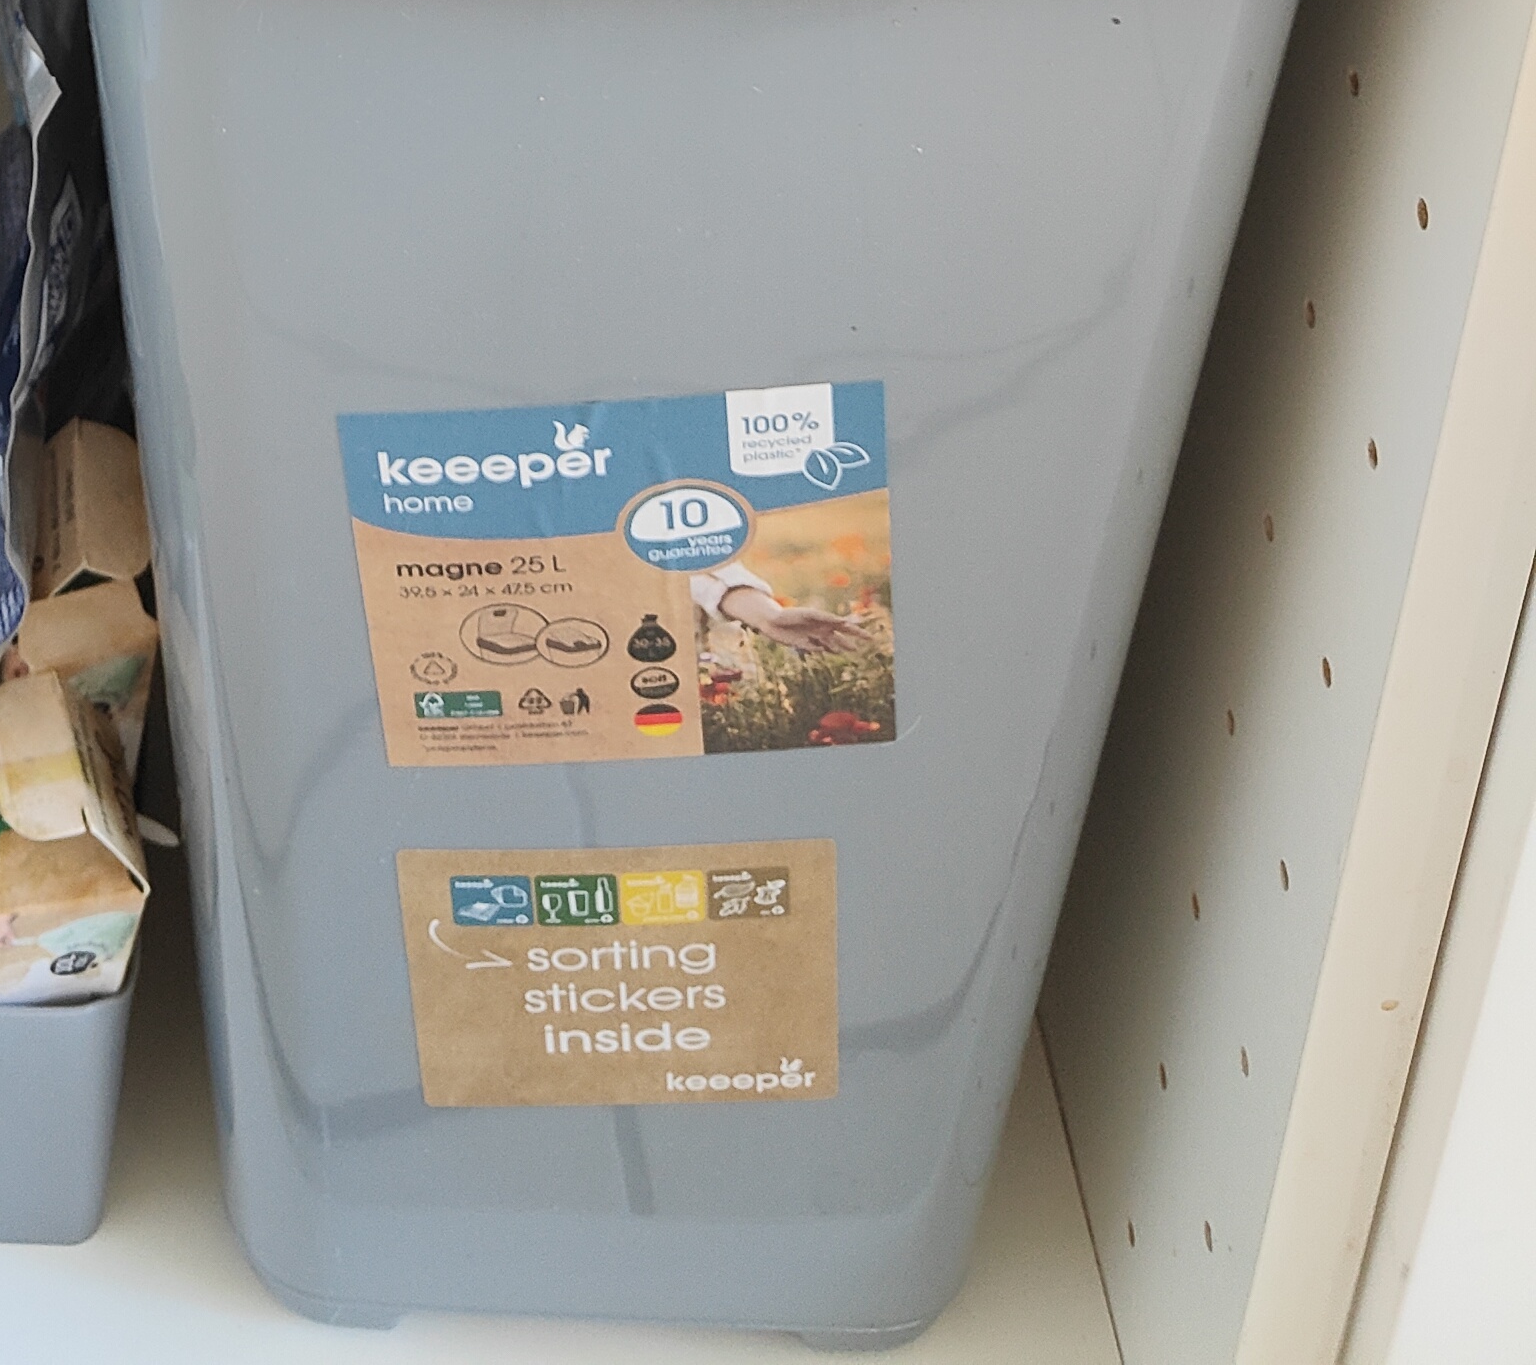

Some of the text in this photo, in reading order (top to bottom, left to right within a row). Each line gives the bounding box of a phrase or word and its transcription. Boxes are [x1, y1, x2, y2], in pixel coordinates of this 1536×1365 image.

[742, 434, 812, 449] recycled
[377, 447, 612, 489] keeeper
[383, 493, 474, 514] home
[659, 498, 709, 529] 10
[647, 544, 733, 562] guarantee
[687, 534, 733, 548] years
[396, 555, 567, 581] magne 25 L
[458, 584, 479, 597] 24
[540, 582, 573, 594] cm
[526, 940, 717, 975] sorting
[524, 981, 726, 1014] stickers
[543, 1022, 711, 1054] inside
[666, 1071, 816, 1094] keeeper
